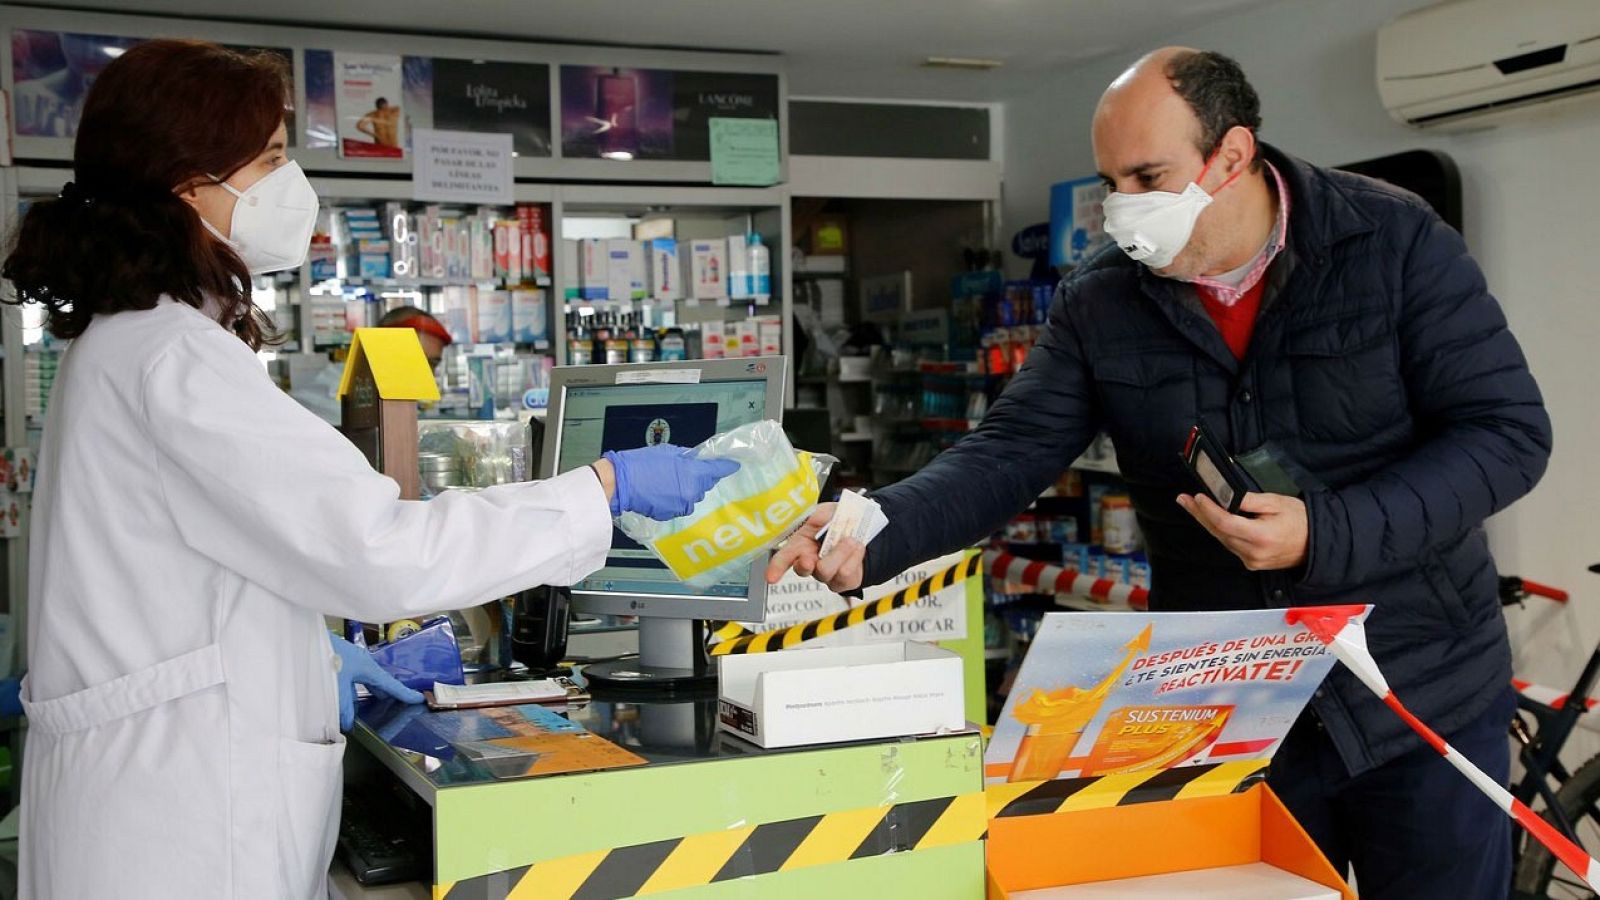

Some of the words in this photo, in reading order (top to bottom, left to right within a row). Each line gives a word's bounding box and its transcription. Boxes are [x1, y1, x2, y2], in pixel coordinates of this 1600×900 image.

[431, 146, 449, 154] POR
[486, 149, 500, 158] NO
[895, 570, 927, 585] POR
[769, 580, 823, 595] RADECE
[794, 599, 823, 612] CON
[868, 621, 892, 636] NO
[897, 617, 955, 635] TOCAR
[1132, 643, 1219, 671] DESPUÉS
[1221, 638, 1248, 652] DE
[1250, 634, 1287, 649] UNA
[1125, 668, 1157, 686] ¿TE
[1160, 656, 1229, 678] SIENTES
[1233, 651, 1259, 664] SIN
[1125, 708, 1218, 724] SUSTENIUM
[1118, 723, 1172, 736] PLUS
